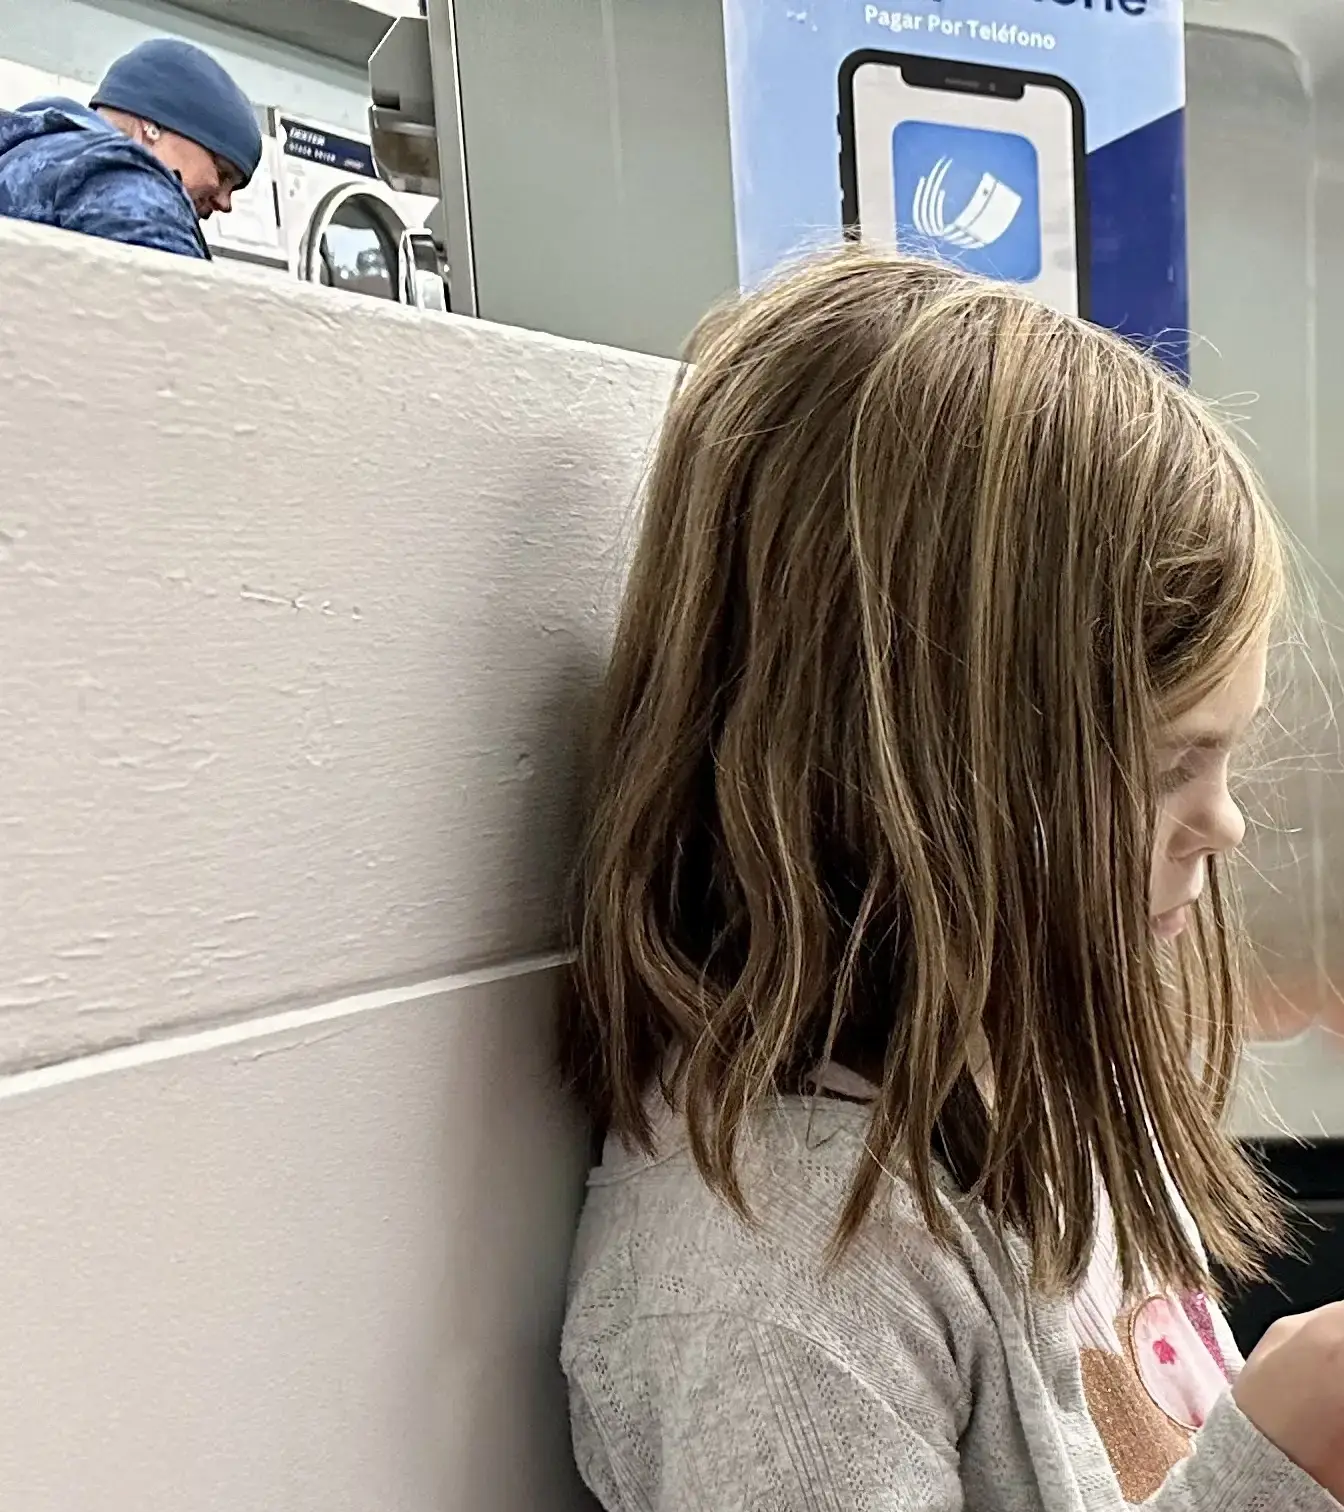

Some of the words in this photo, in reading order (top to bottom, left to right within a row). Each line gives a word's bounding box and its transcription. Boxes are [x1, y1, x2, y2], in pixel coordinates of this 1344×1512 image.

[864, 5, 922, 33] Pagar
[927, 14, 961, 36] Por
[967, 19, 1056, 50] Teléfono
